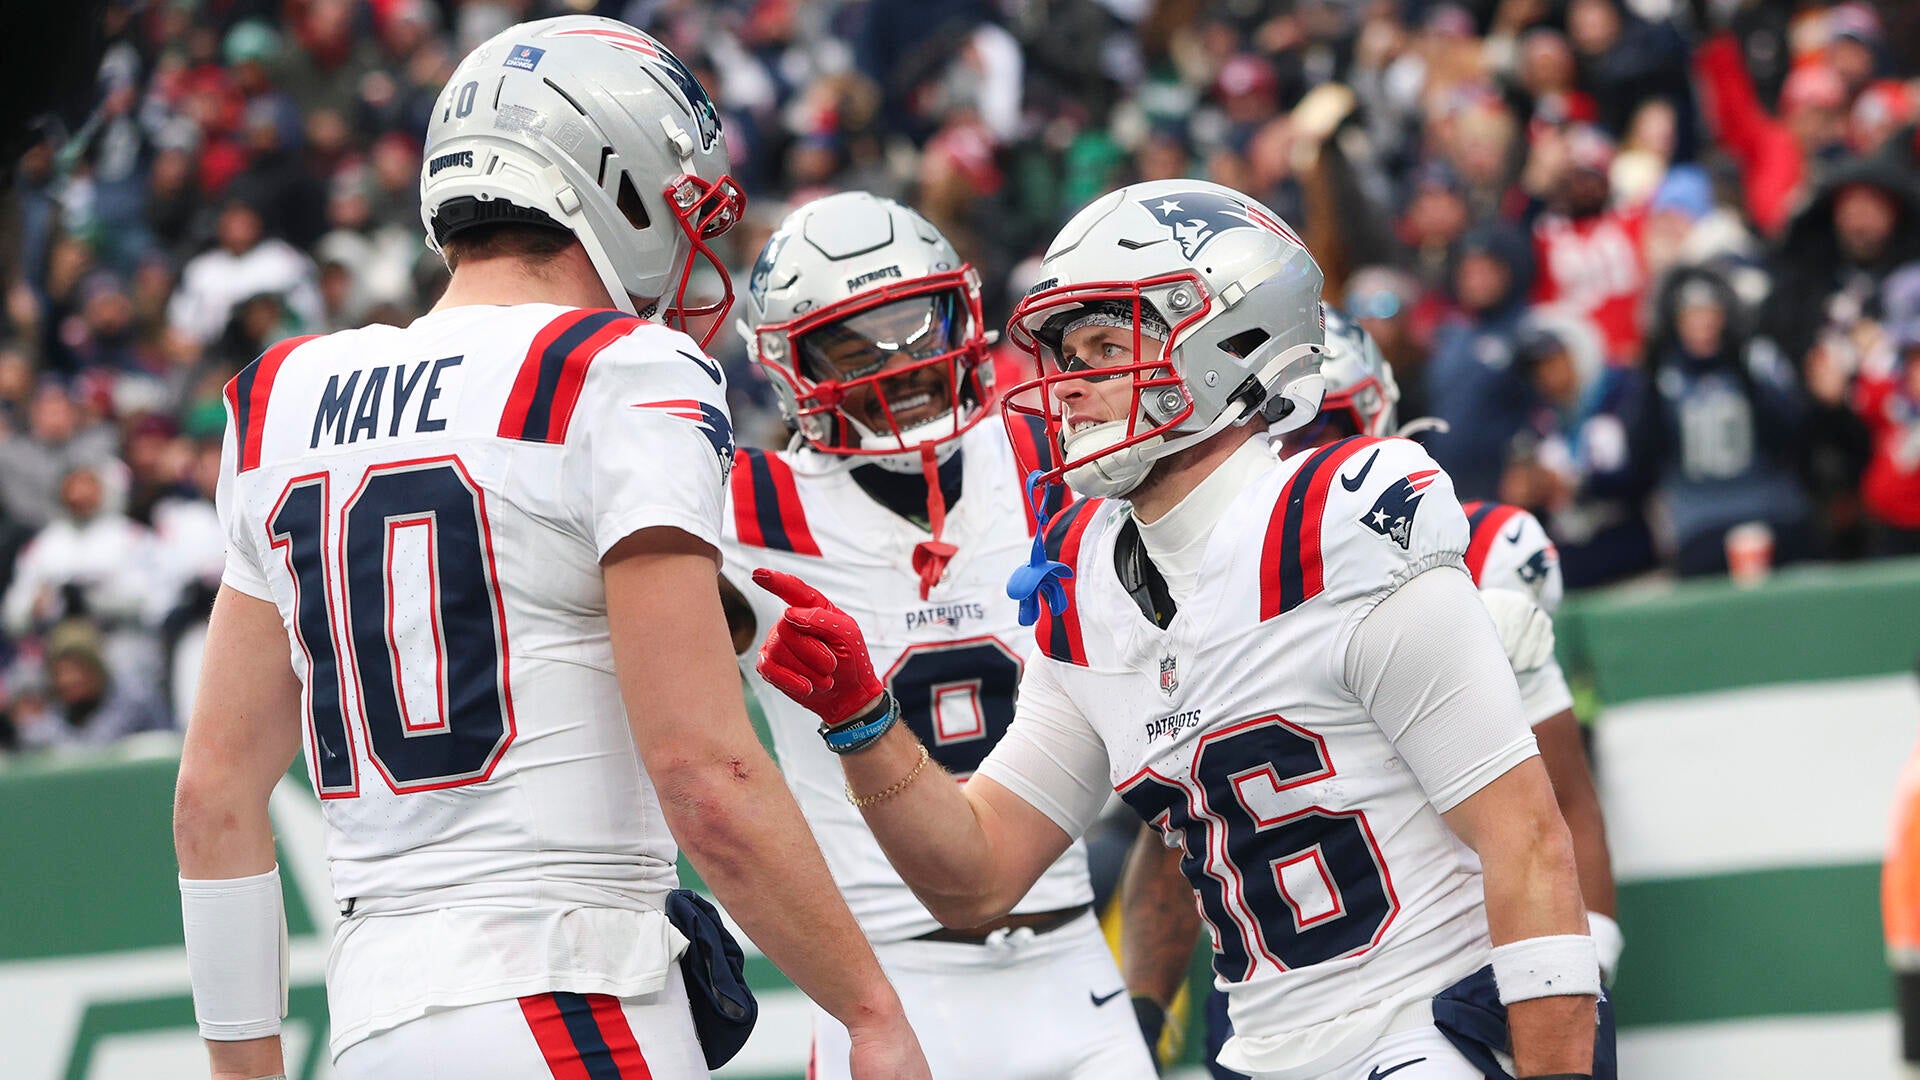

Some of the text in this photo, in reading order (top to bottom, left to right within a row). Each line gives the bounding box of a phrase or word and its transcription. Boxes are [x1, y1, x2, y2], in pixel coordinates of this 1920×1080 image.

[847, 265, 902, 293] PATRIOTS
[309, 355, 464, 449] MAYE
[265, 454, 516, 799] 10
[906, 603, 983, 630] PATRIOTS
[1161, 671, 1176, 688] NFL
[1146, 709, 1201, 744] PATRIOTS
